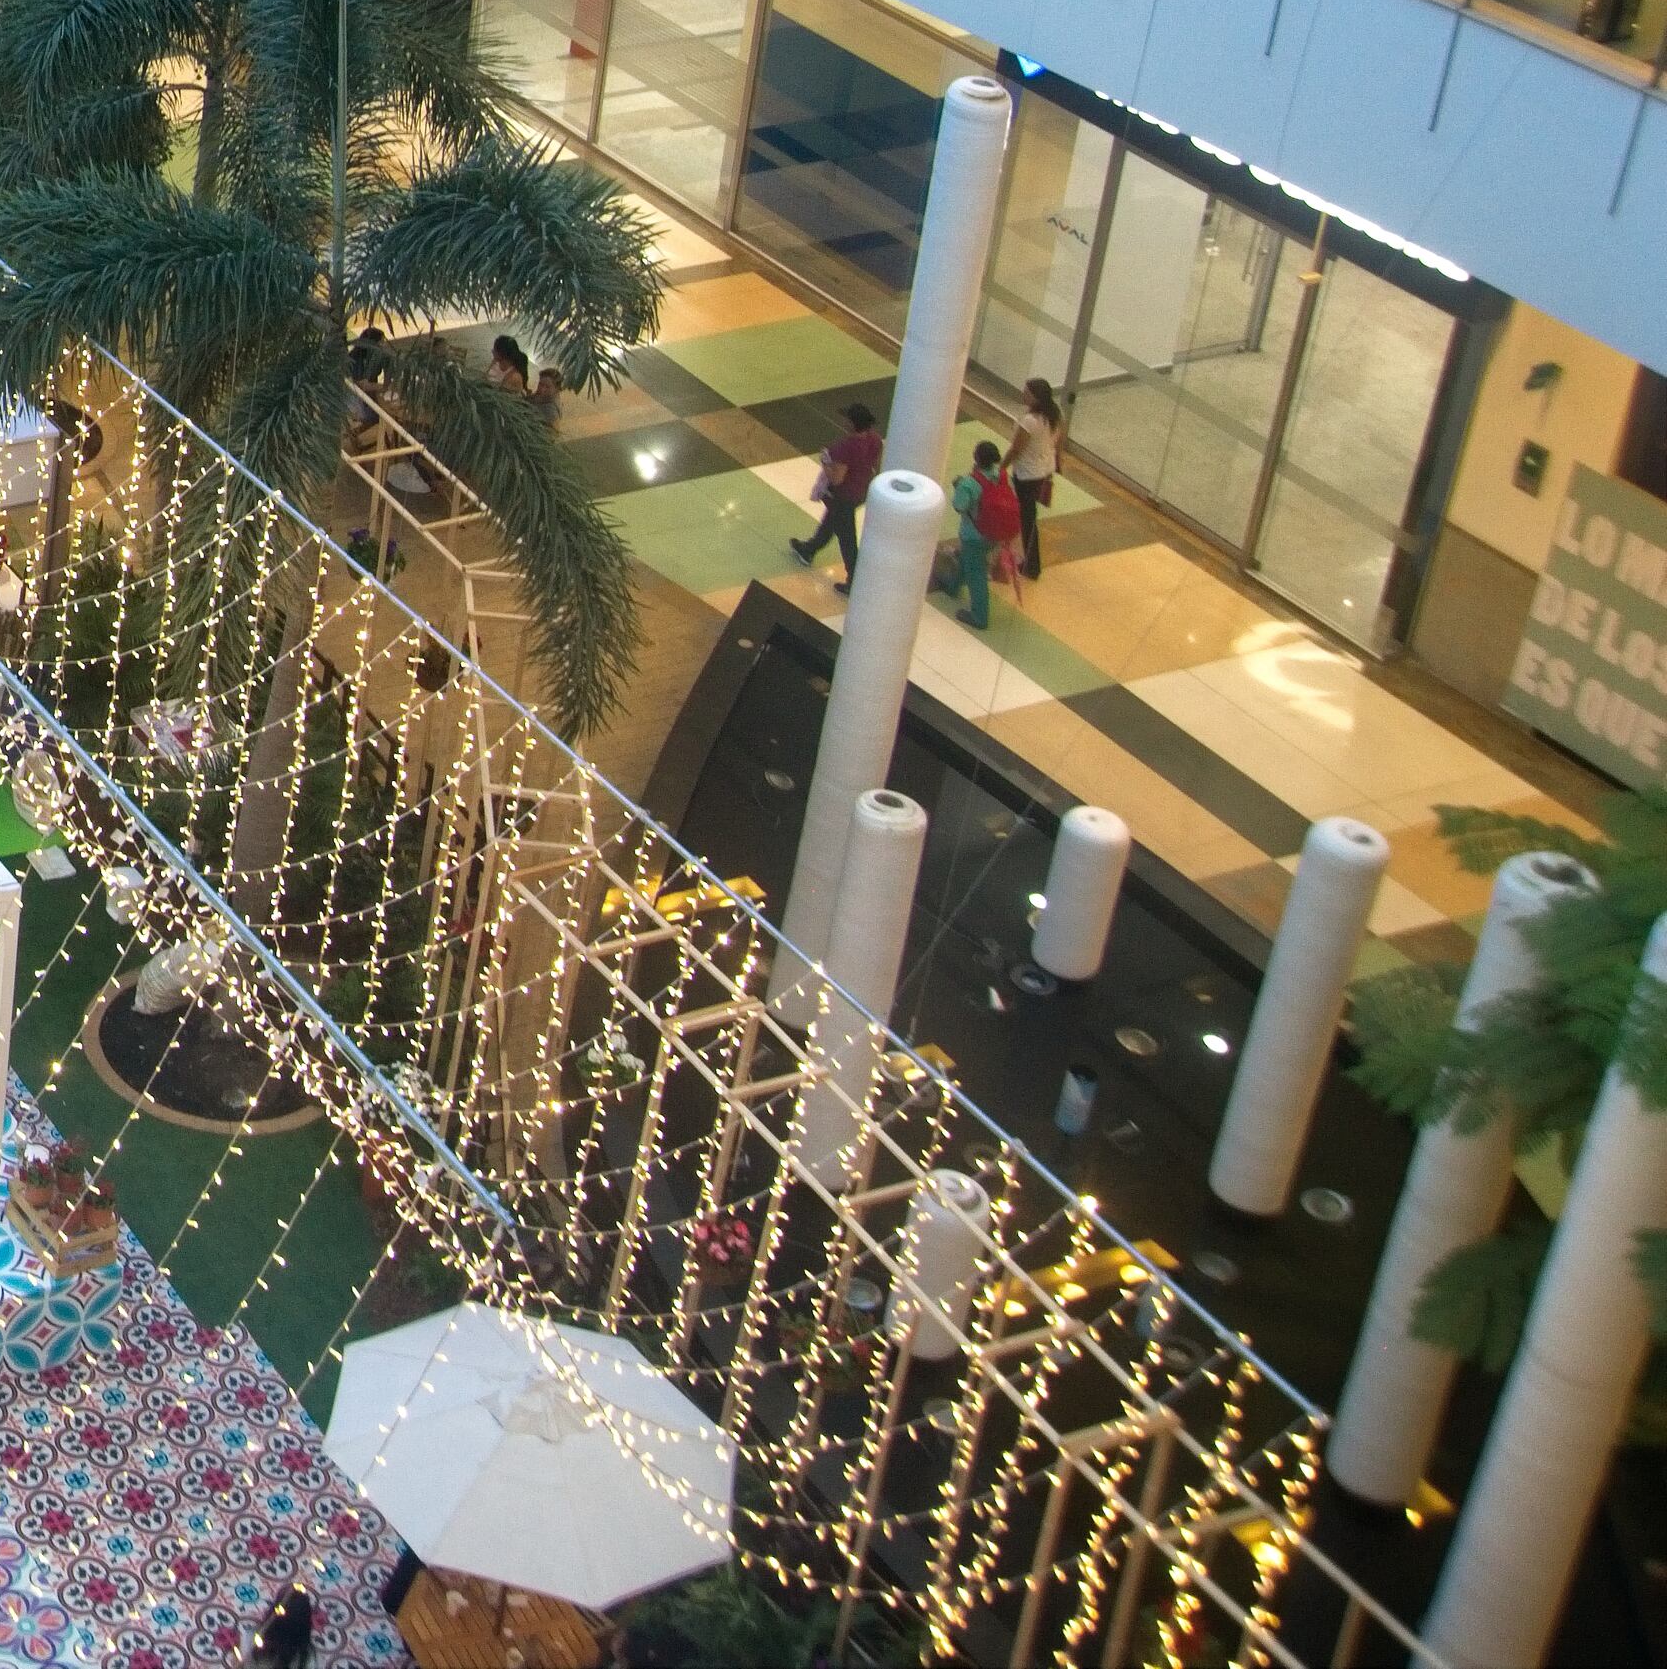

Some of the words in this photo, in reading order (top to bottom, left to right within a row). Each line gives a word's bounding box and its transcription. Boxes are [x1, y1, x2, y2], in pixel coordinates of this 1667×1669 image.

[1554, 497, 1616, 569] LO
[1530, 571, 1599, 644] DE
[1511, 638, 1575, 710] ES
[1574, 678, 1667, 770] QUE
